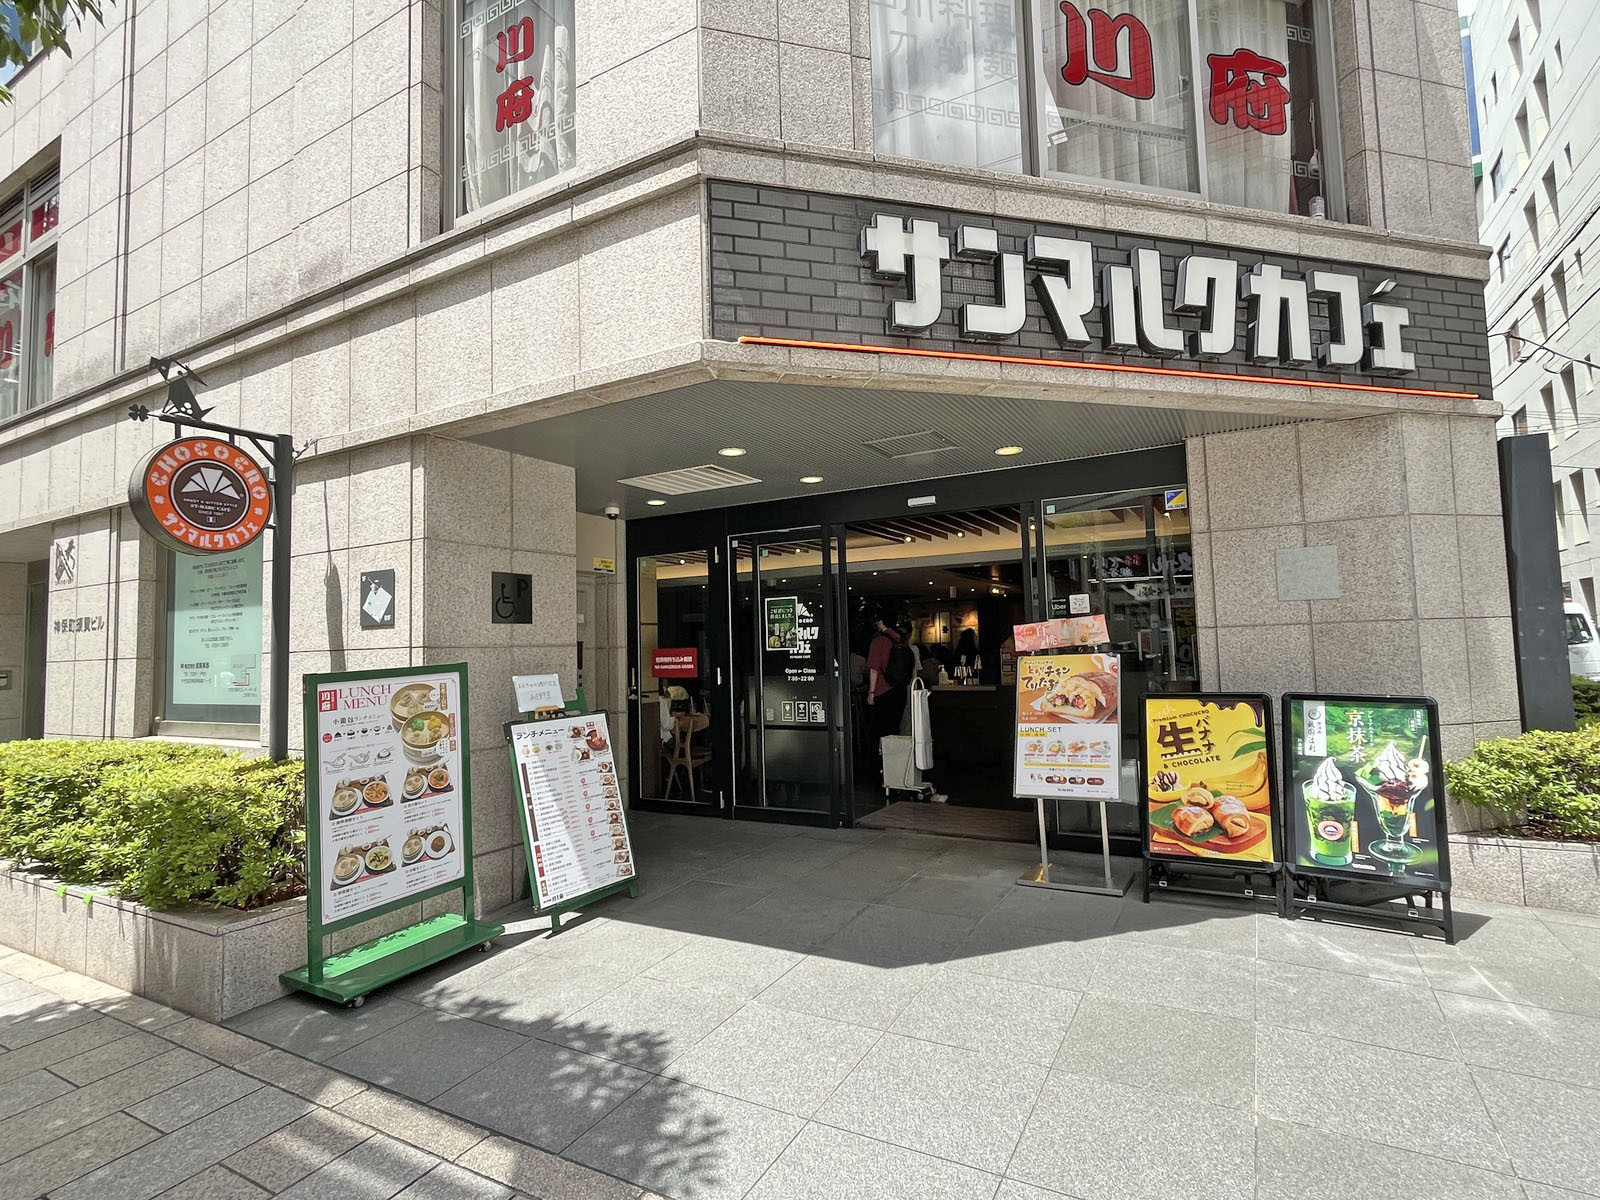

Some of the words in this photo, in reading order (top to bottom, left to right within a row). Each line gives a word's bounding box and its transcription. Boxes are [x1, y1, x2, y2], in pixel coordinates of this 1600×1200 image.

[862, 213, 1416, 375] サンマルクカフェ
[150, 442, 230, 487] CHOCO
[233, 456, 267, 500] CRO
[163, 512, 260, 548] サンマルクカフェ
[517, 579, 529, 598] P
[338, 683, 392, 700] LUNCH
[343, 694, 388, 711] MENU
[1178, 709, 1210, 719] CHOCOCRO
[516, 728, 565, 740] ランチメニュー
[1157, 721, 1203, 759] 生
[1196, 716, 1216, 755] バナナ
[1346, 709, 1368, 763] 京抹茶
[1171, 754, 1222, 768] CHOCOLATE
